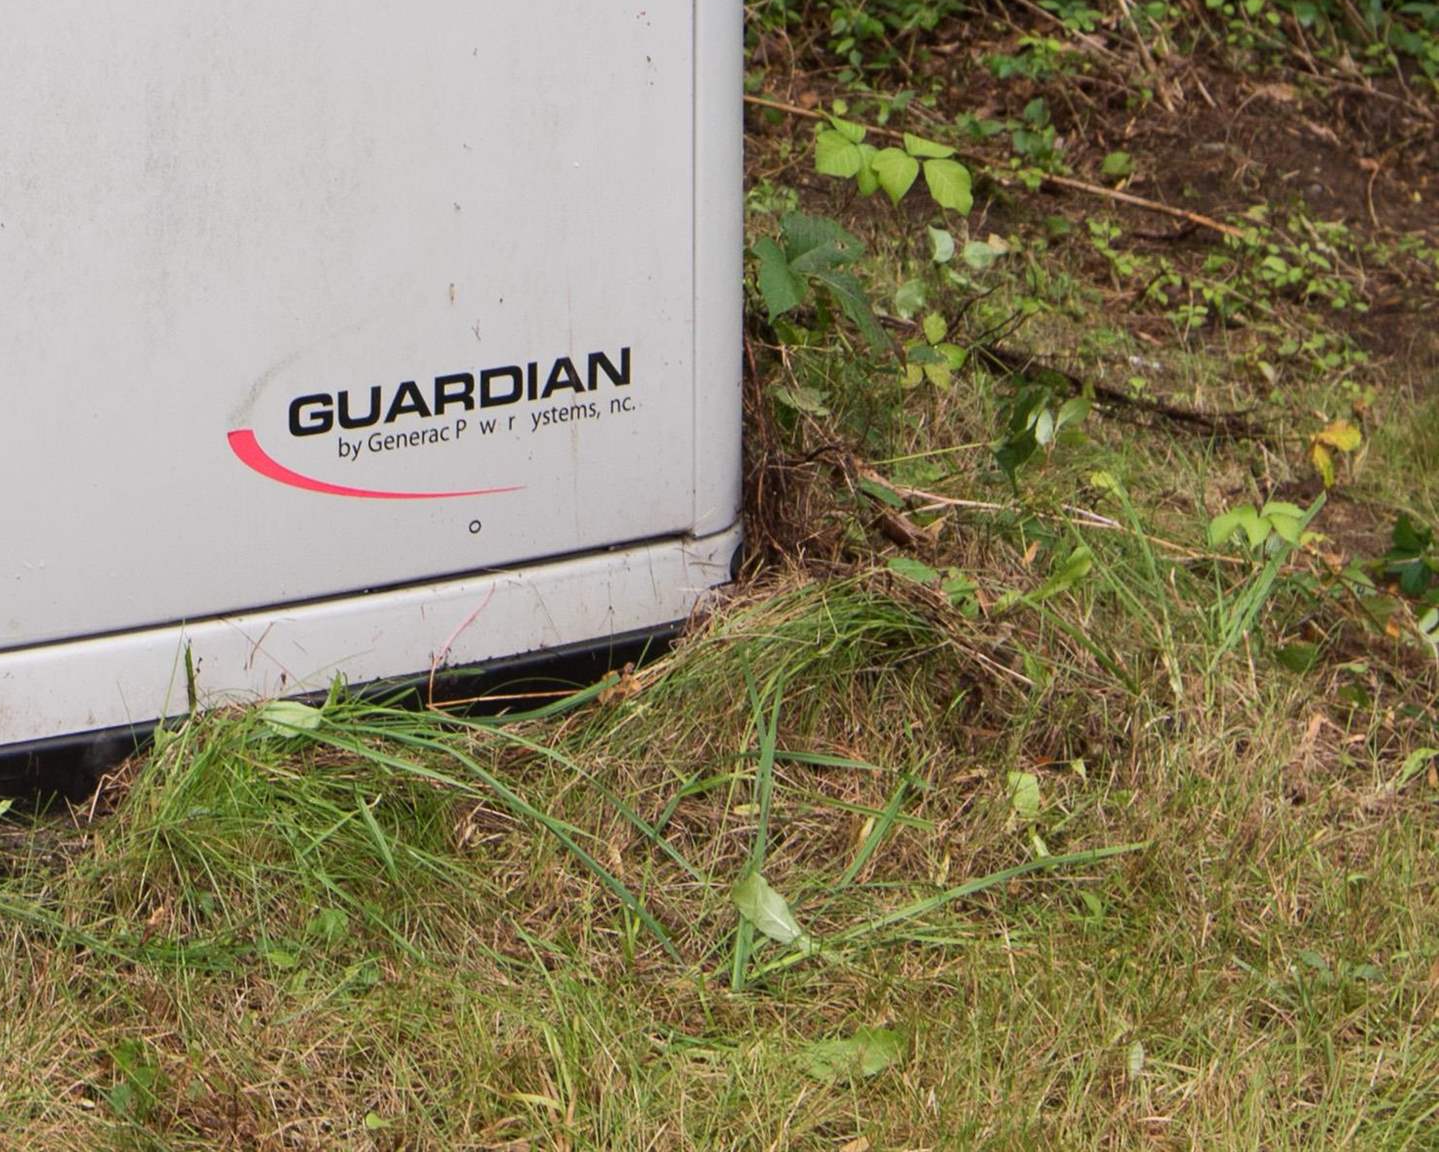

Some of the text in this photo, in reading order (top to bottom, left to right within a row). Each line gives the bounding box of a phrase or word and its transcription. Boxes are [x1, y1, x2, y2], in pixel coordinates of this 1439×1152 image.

[288, 347, 631, 437] GUARDIAN
[338, 395, 637, 461] by Generac Pwr ystems, nc.
